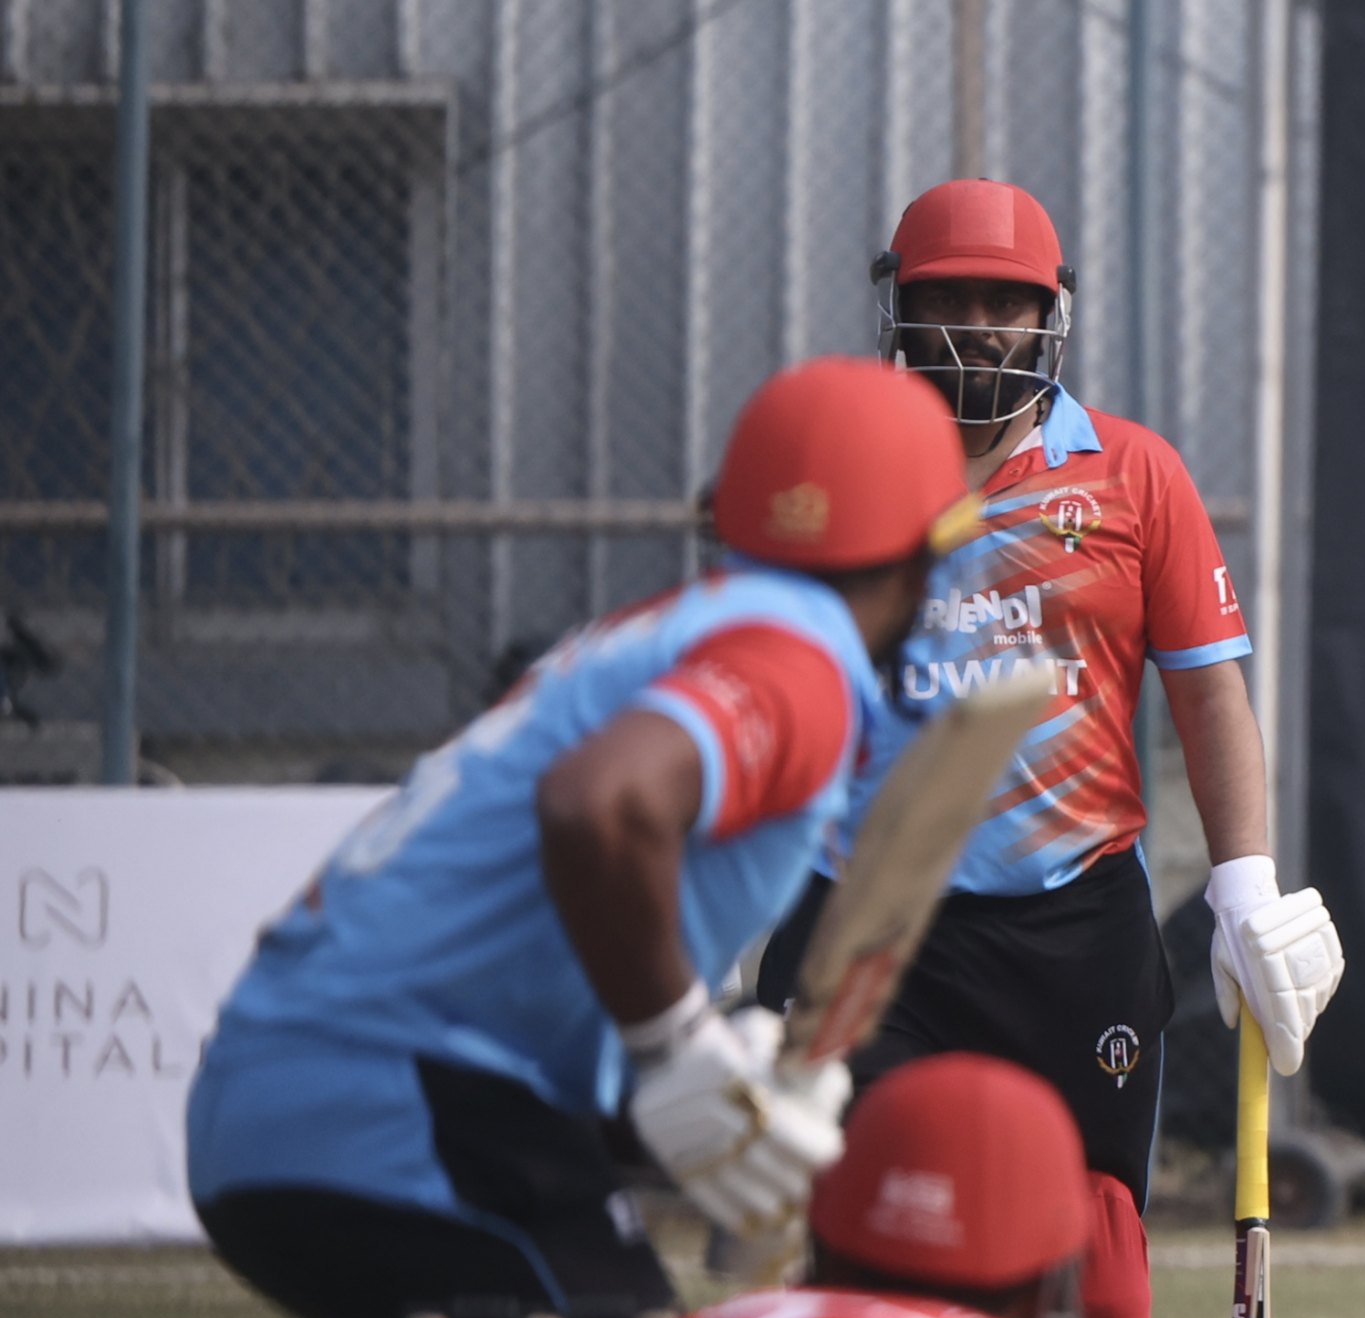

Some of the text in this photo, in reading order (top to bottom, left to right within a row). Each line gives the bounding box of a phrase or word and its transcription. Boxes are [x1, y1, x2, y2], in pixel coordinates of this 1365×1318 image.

[1039, 486, 1102, 517] KUWAIT CRICKET
[924, 585, 1043, 634] RIENDI
[994, 631, 1042, 646] mobile
[903, 658, 1088, 700] UWAIT
